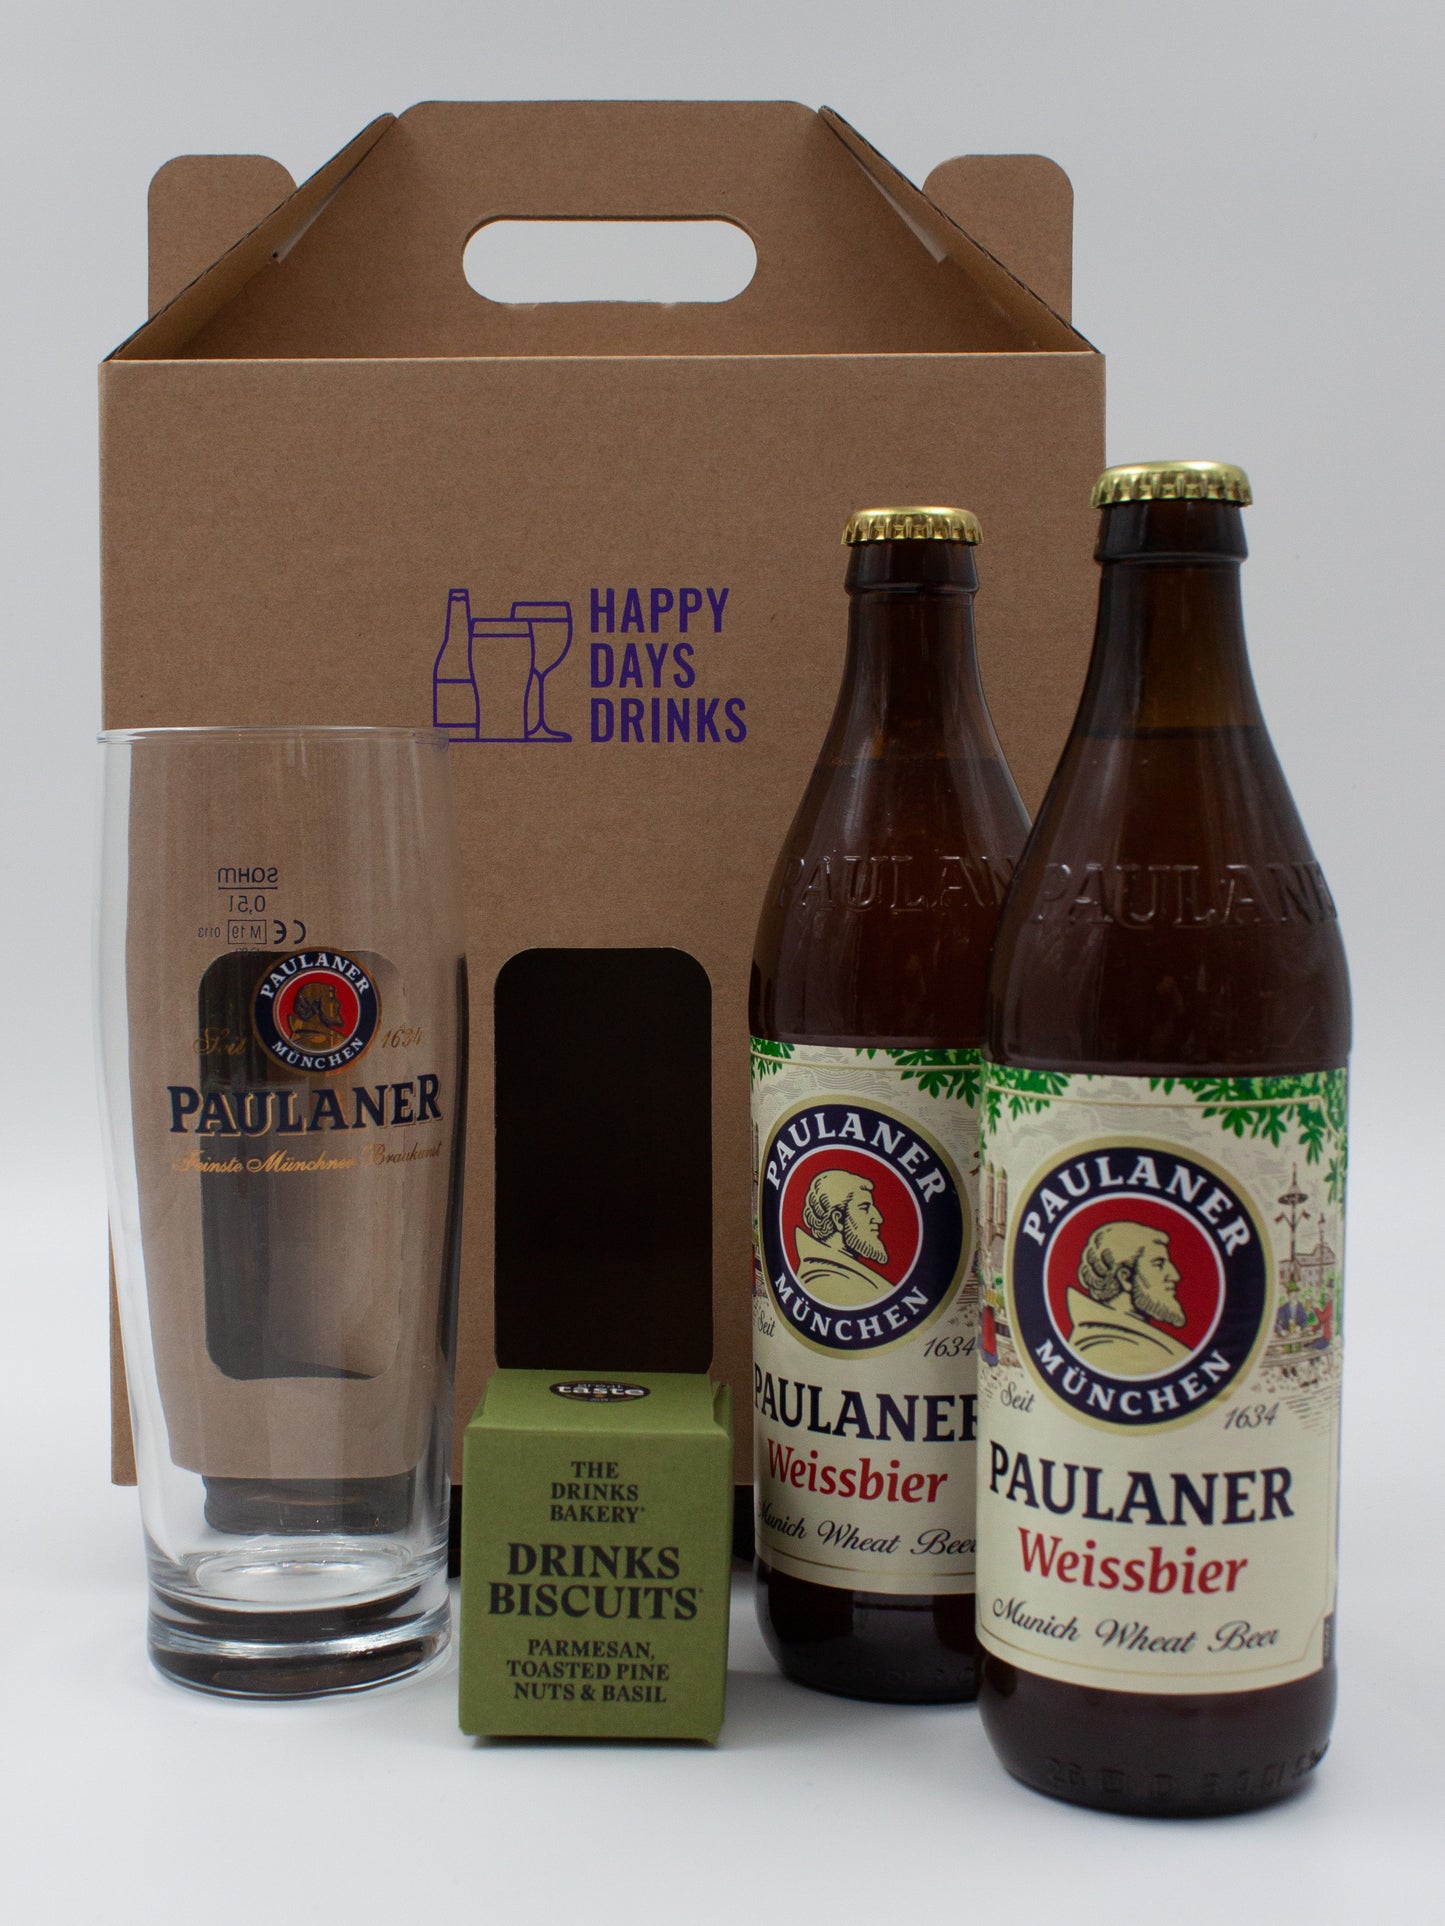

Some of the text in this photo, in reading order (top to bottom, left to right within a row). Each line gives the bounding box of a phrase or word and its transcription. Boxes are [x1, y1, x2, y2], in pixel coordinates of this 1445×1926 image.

[590, 588, 729, 633] HAPPY
[590, 642, 696, 688] DAYS
[590, 698, 748, 743] DRINKS
[260, 952, 370, 1000] PAULANER
[272, 1036, 364, 1070] MÜNCHEN
[381, 1026, 424, 1050] 1634
[167, 1073, 443, 1138] PAULANER
[766, 1112, 946, 1203] PAULANER
[1023, 1155, 1250, 1256] PAULANER
[775, 1272, 929, 1341] MÜNCHEN
[923, 1335, 976, 1358] 1634
[1035, 1339, 1232, 1416] MÜNCHEN
[1001, 1381, 1280, 1430] Seit 1634
[551, 1482, 639, 1502] DRINKS
[571, 1461, 619, 1479] THE
[767, 1438, 948, 1504] Weissbier
[989, 1440, 1295, 1527] PAULANER
[817, 1520, 901, 1555] Wheat
[1018, 1526, 1248, 1594] Weissbier
[507, 1542, 681, 1581] DRINKS
[488, 1581, 699, 1621] BISCUITS
[992, 1597, 1280, 1654] Munich Wheat Beer
[507, 1660, 670, 1682] TOASTED PINE
[528, 1638, 656, 1660] PARMESAN,
[514, 1682, 667, 1704] NUTS & BASIL
